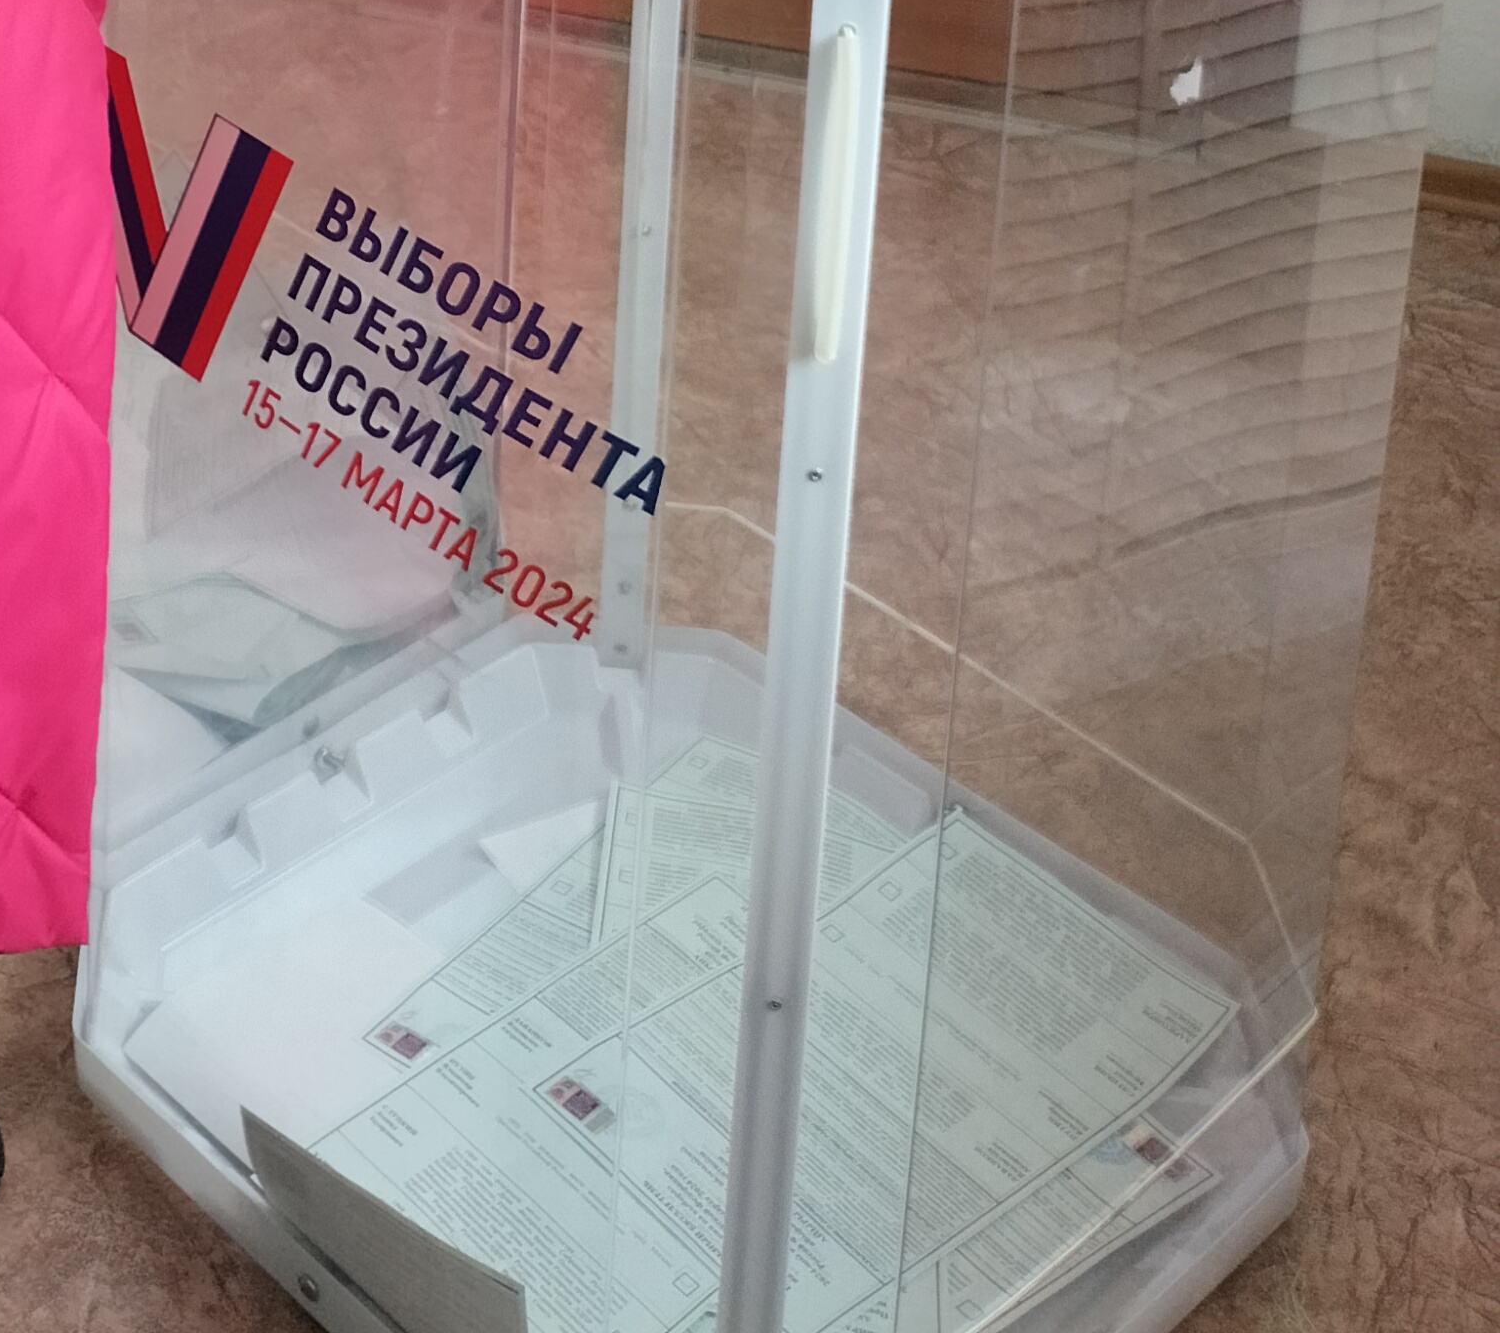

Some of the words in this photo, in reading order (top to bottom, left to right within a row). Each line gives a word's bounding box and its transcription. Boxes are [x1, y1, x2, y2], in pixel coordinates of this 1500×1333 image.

[314, 187, 583, 375] ВЫБОРЫ
[261, 316, 484, 493] РОССИИ
[287, 253, 667, 517] ПРЕЗИДЕНТА
[341, 450, 479, 572] МАРТА
[483, 547, 598, 641] 2024
